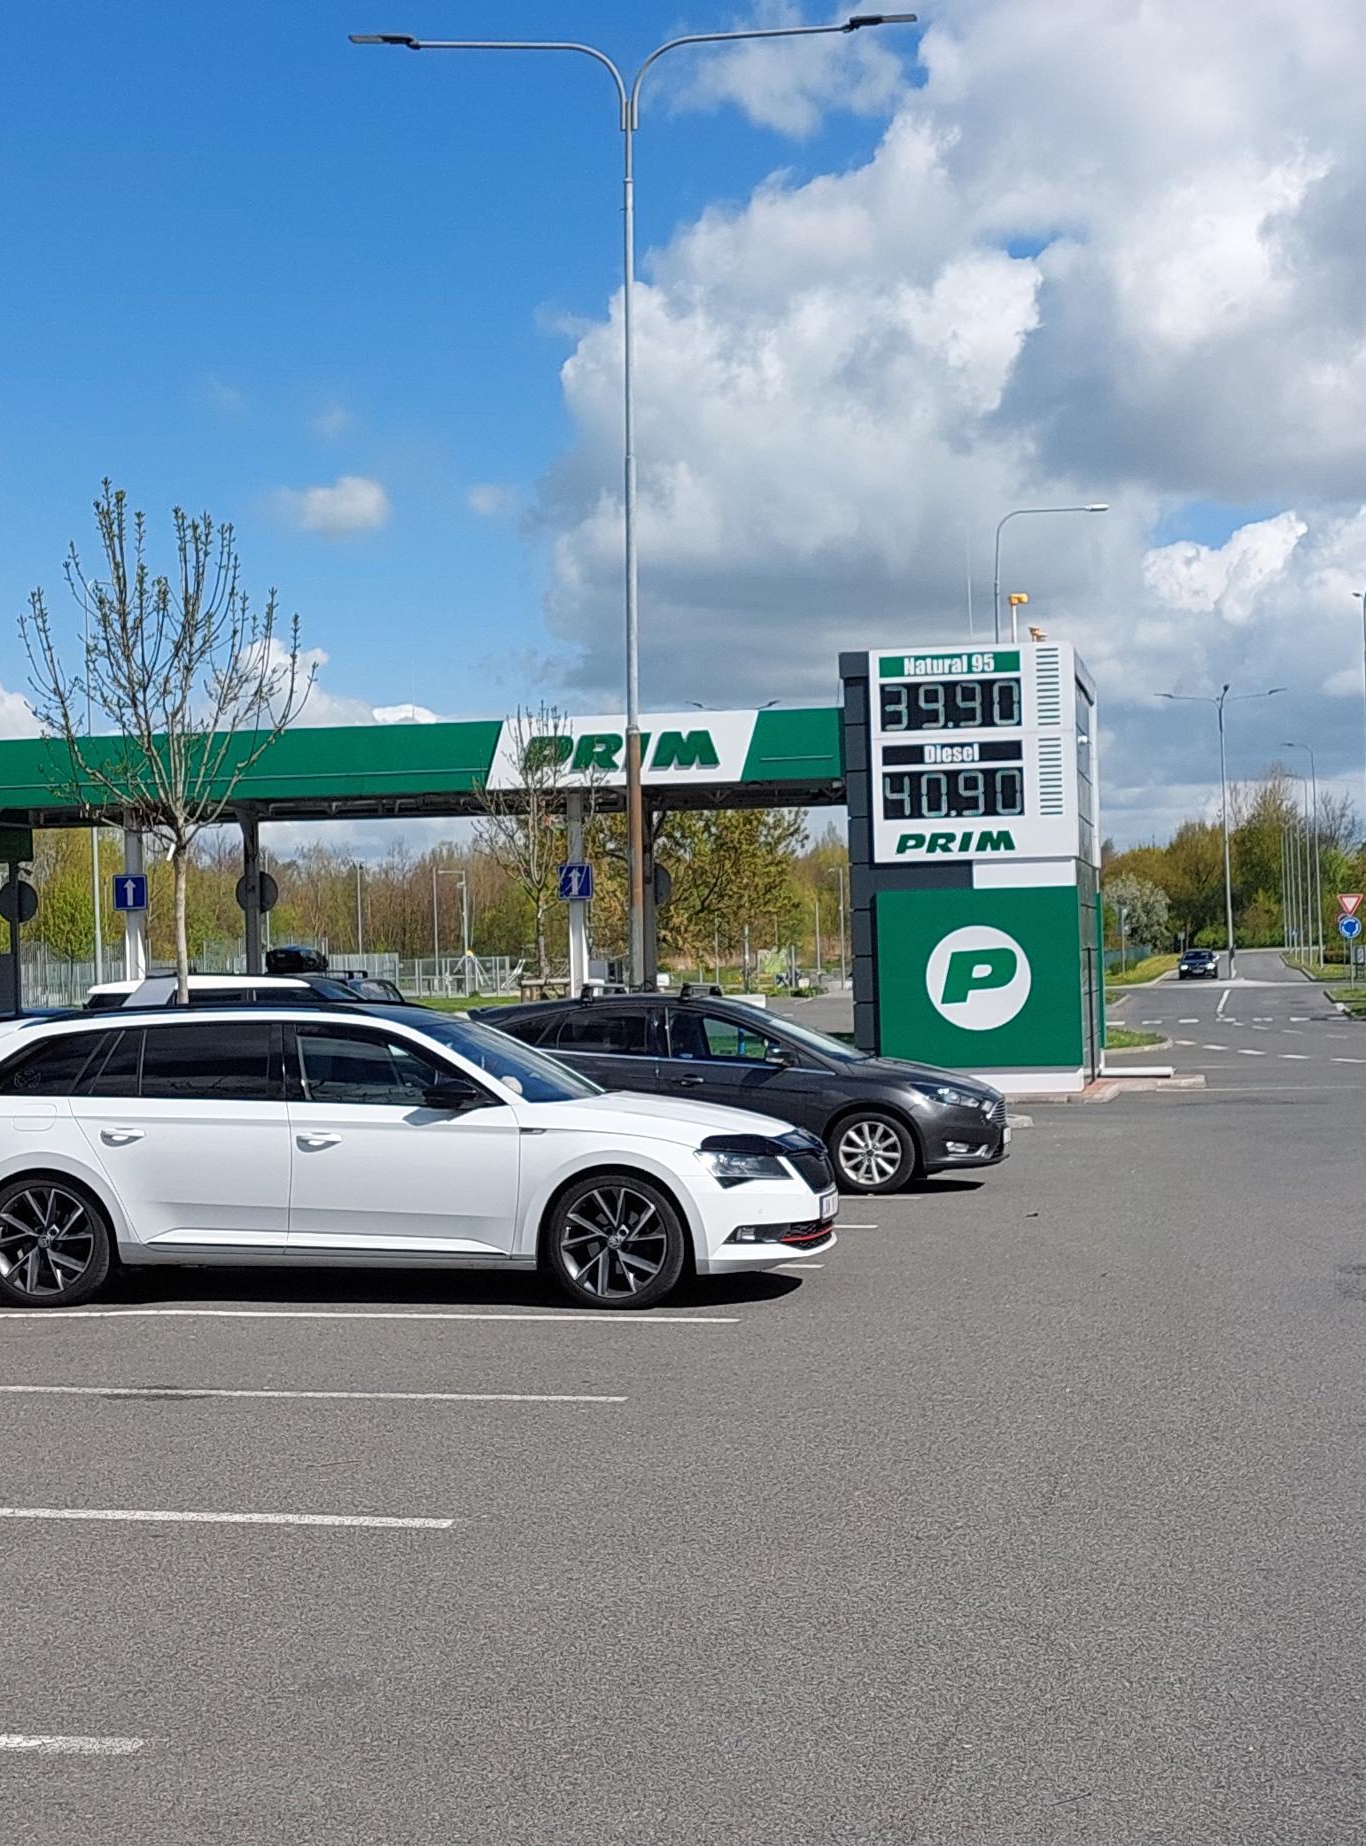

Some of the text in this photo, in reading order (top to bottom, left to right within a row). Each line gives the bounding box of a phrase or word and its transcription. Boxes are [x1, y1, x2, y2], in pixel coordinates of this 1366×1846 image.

[903, 654, 995, 677] Natural 95
[883, 679, 1020, 731] 39.90
[923, 742, 980, 764] Diesel
[884, 768, 1022, 818] 40.90
[895, 829, 1016, 854] PRIM
[940, 947, 1018, 1005] P
